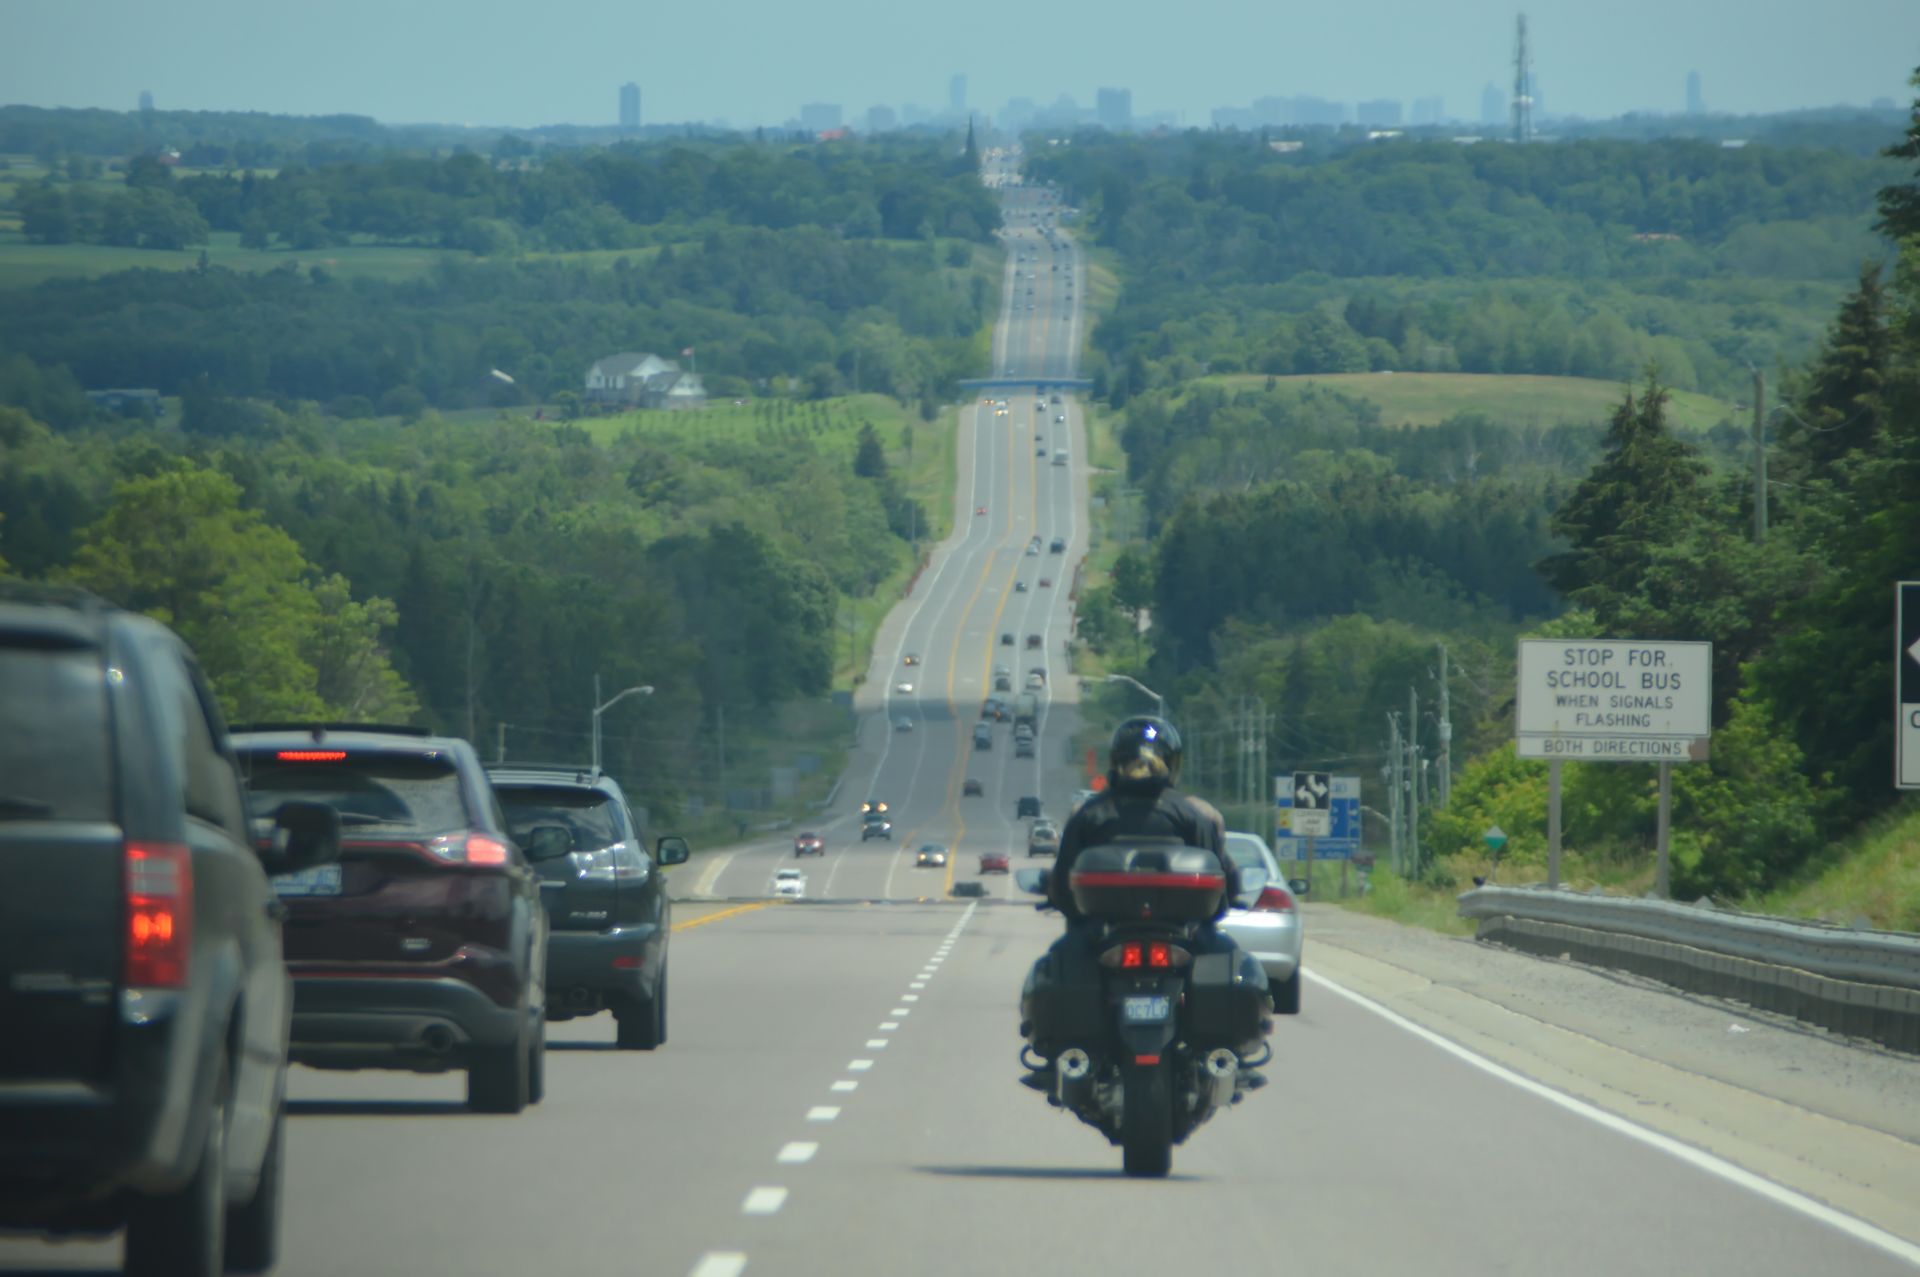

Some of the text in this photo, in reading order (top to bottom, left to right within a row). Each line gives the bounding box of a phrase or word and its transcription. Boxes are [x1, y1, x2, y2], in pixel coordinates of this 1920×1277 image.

[1564, 648, 1614, 666] STOP
[1547, 670, 1682, 690] SCHOOL BUS
[1556, 694, 1674, 710] WHEN SIGNALS
[1576, 713, 1651, 728] FLASHING
[1543, 740, 1682, 755] BOTH DIRECTIONS
